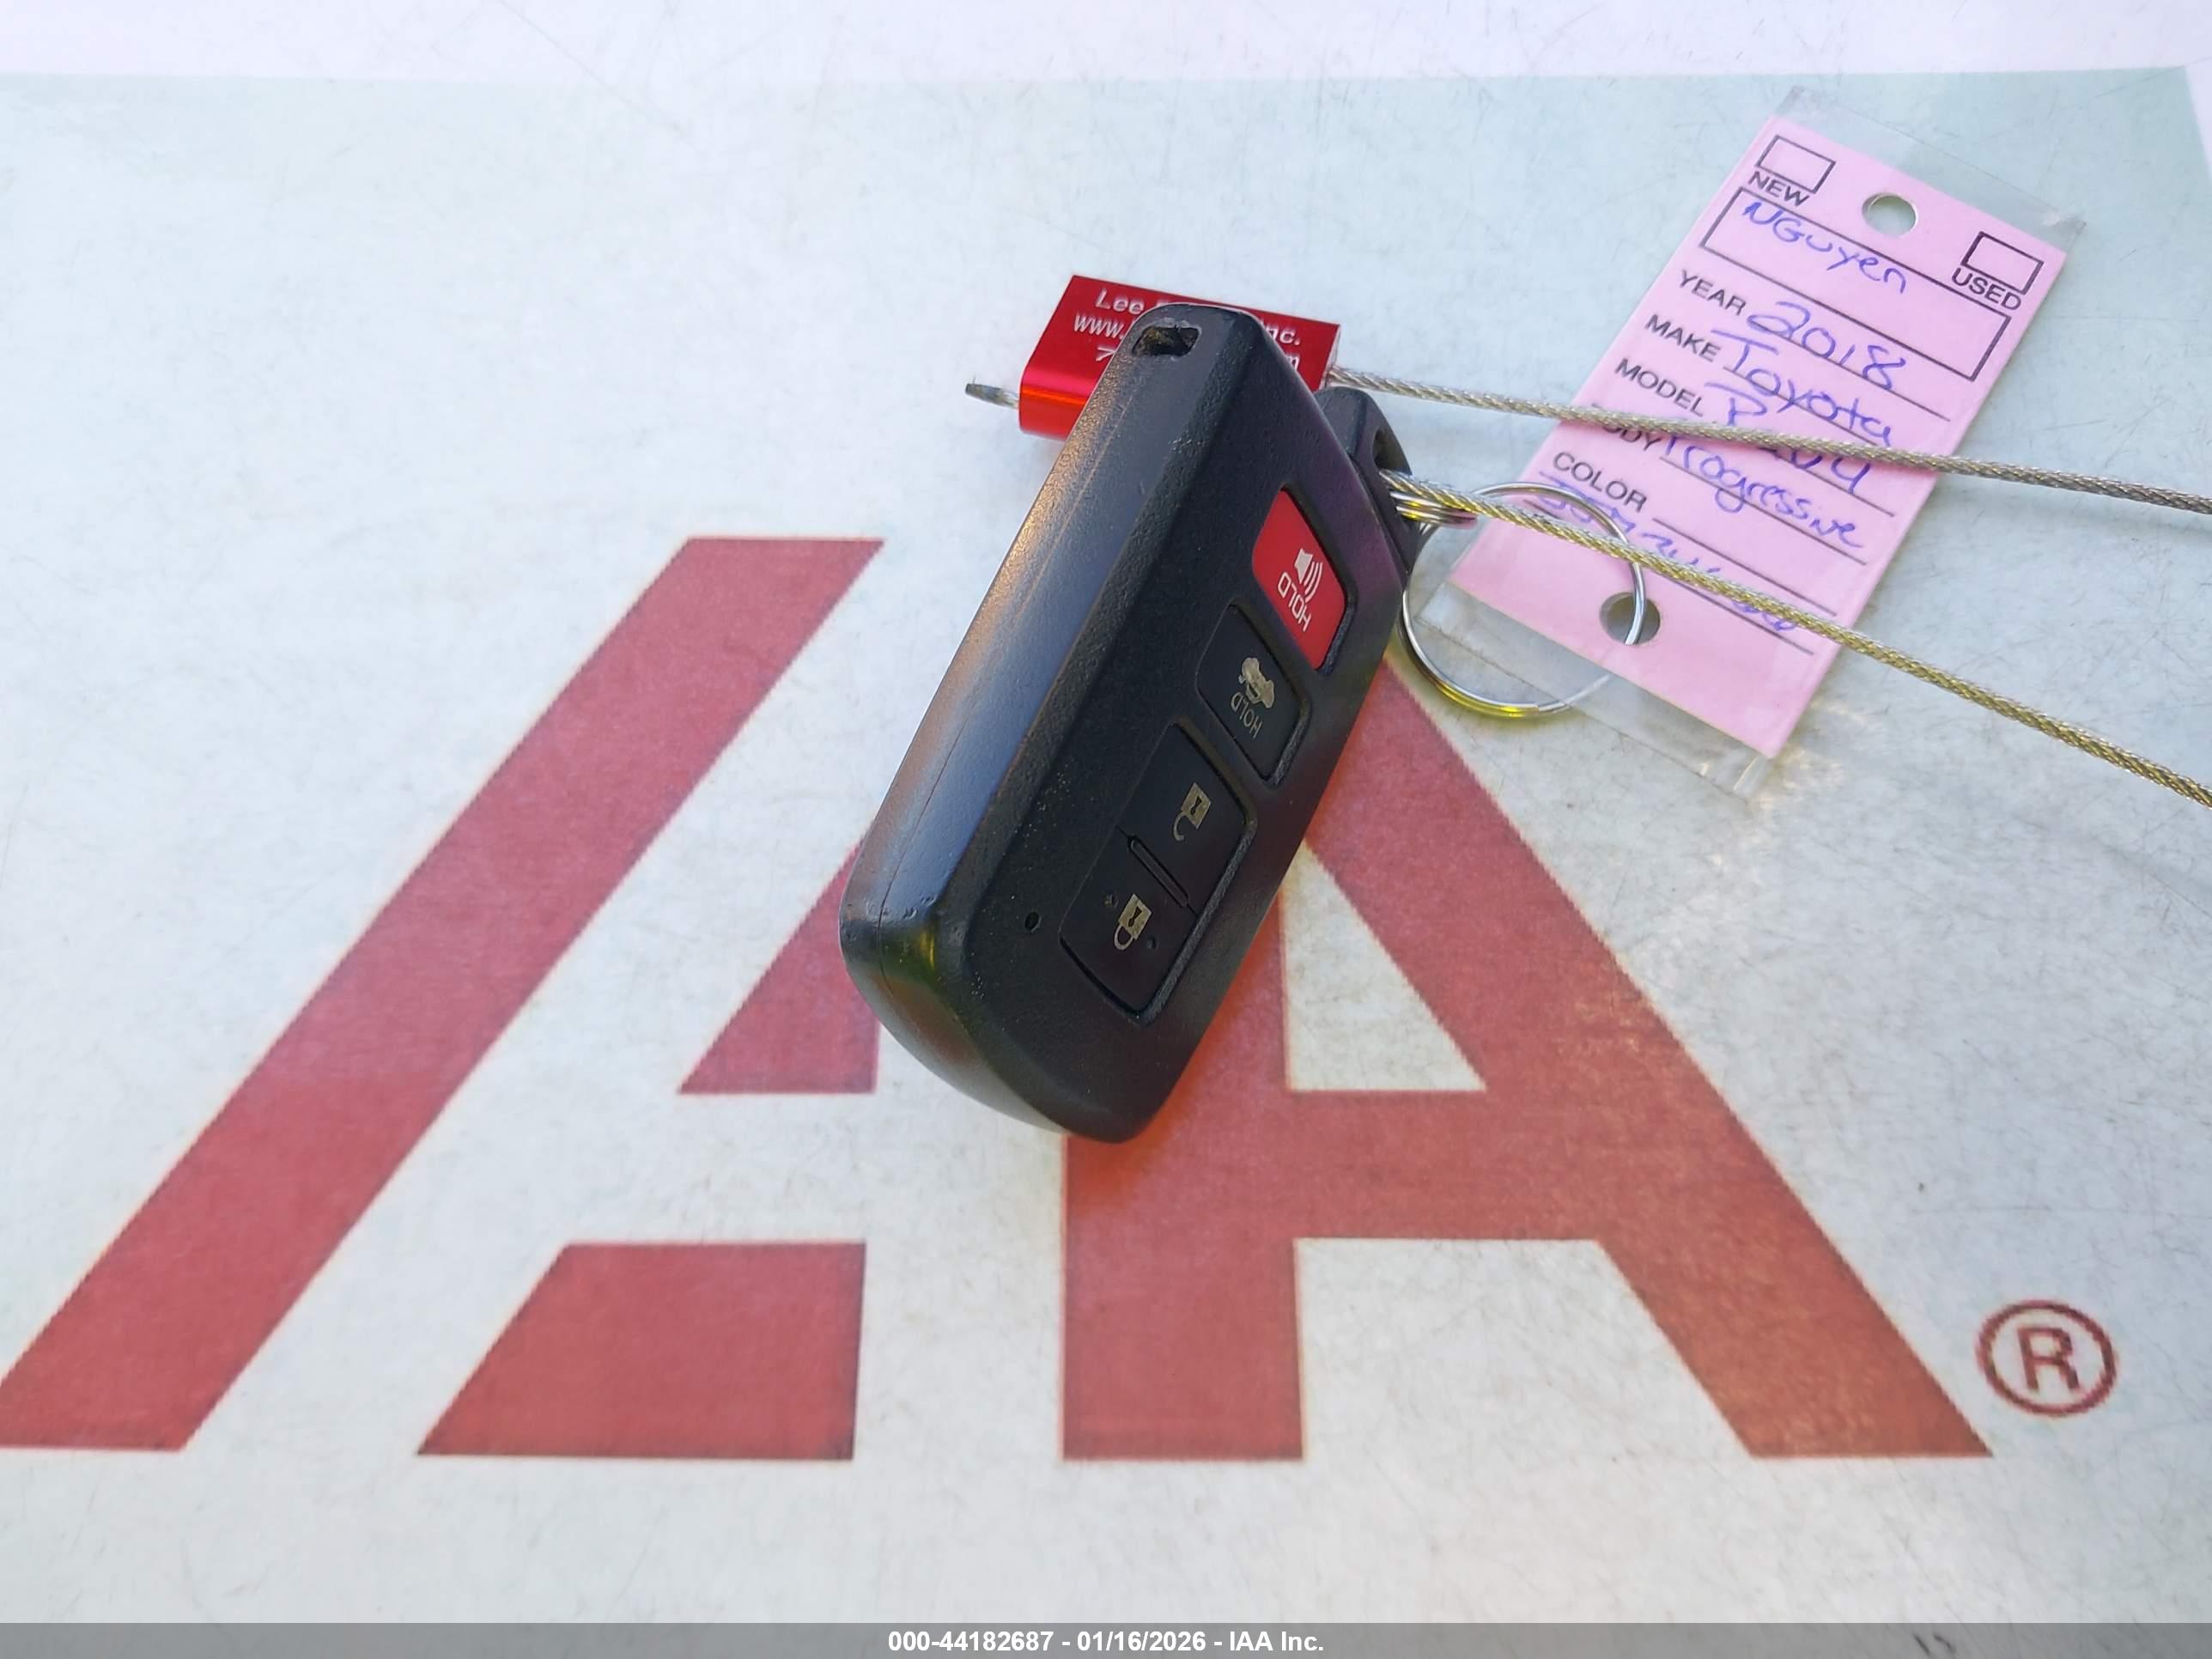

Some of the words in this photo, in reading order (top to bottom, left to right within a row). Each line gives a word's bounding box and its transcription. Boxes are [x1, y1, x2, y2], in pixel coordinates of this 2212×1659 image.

[1747, 171, 1811, 207] NEW
[1094, 288, 1146, 315] Lee
[1679, 269, 1747, 317] YEAR
[1950, 267, 2023, 312] USED
[1644, 314, 1723, 363] MAKE
[1747, 301, 1907, 392] 2018
[1614, 357, 1705, 416] MODEL
[1711, 329, 1892, 447] Toyota
[1552, 451, 1648, 514] COLOR
[1276, 570, 1312, 633] HOLD
[1229, 692, 1263, 739] HOLD
